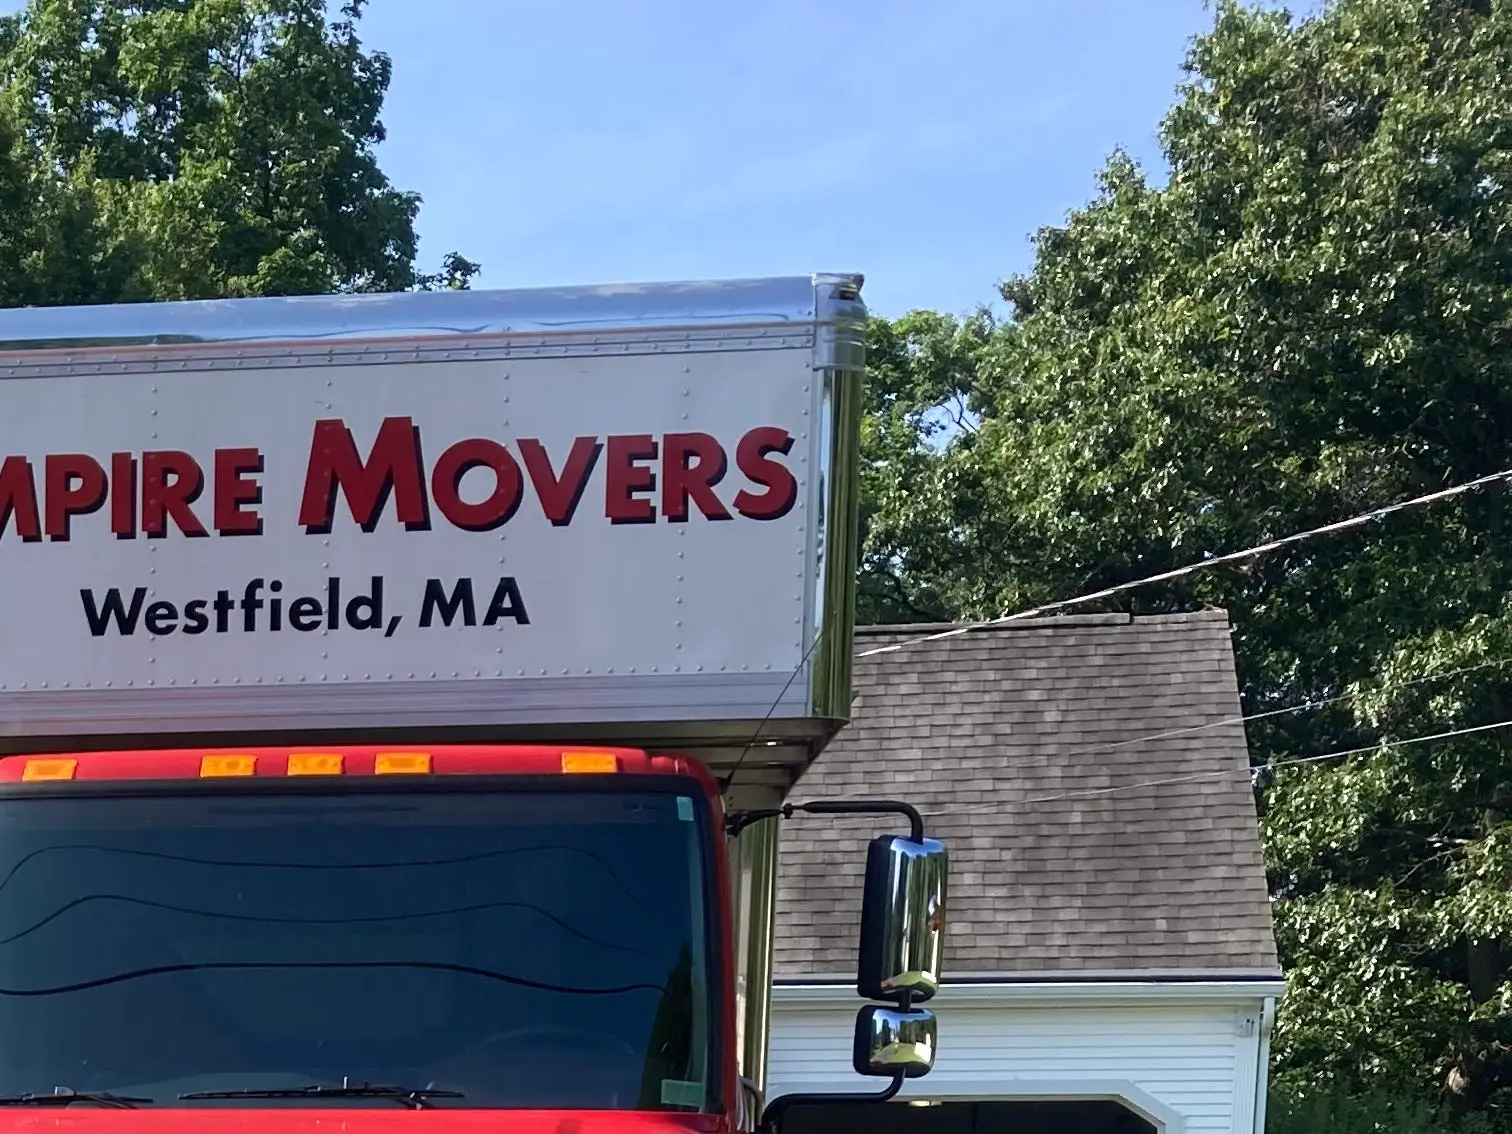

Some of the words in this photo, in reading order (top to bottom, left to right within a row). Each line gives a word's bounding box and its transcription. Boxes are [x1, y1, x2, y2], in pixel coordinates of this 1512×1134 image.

[298, 417, 798, 536] MOVERS
[80, 576, 402, 637] Westfield,
[419, 577, 531, 627] MA
